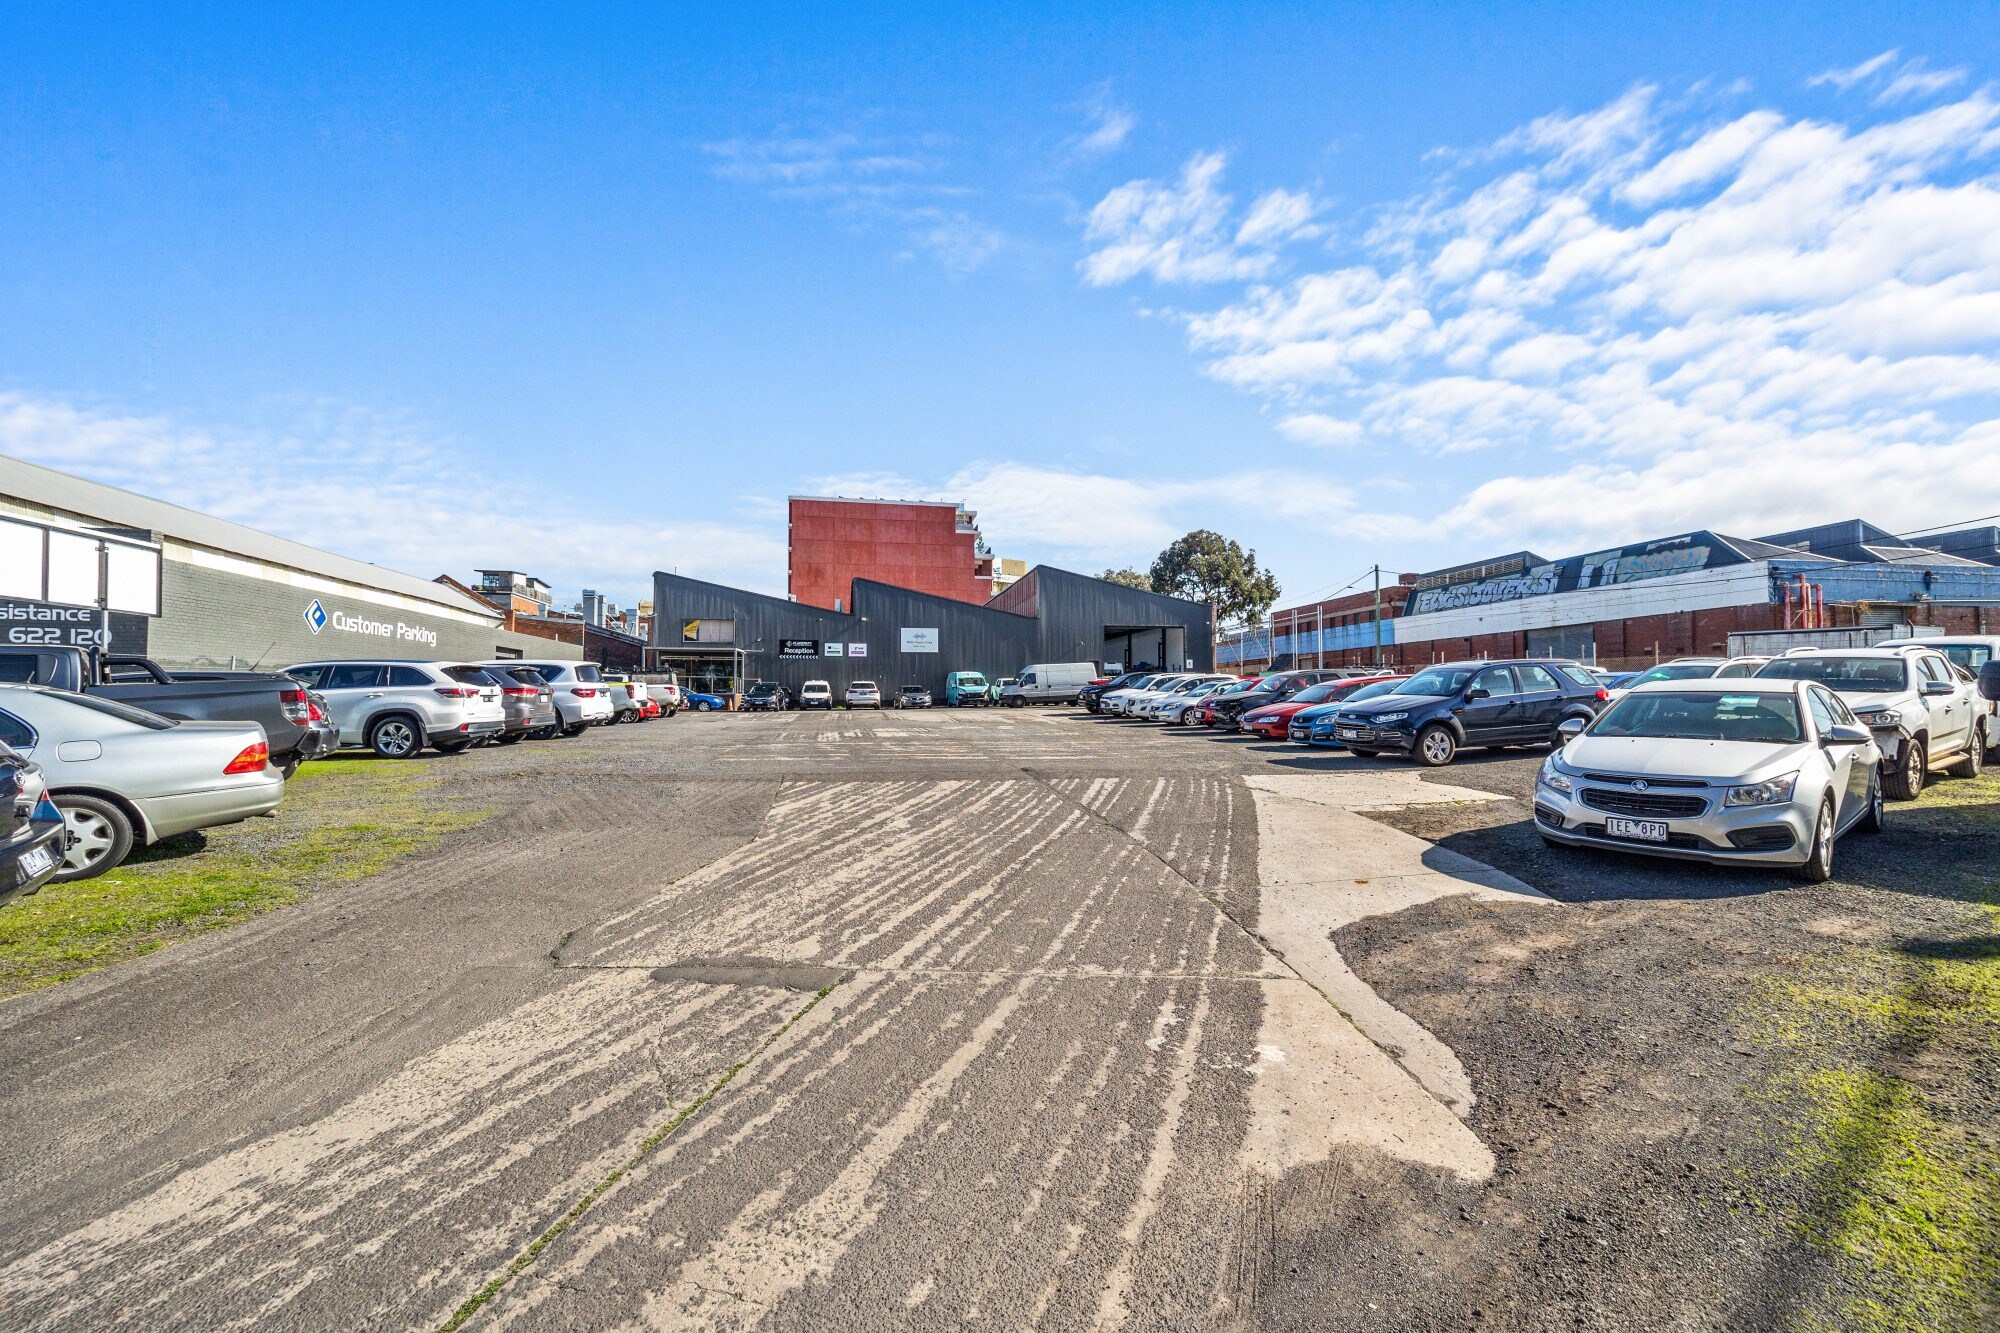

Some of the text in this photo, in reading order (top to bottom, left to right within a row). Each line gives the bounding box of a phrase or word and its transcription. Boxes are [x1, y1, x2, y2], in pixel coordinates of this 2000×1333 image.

[8, 627, 113, 645] 622 120
[332, 611, 437, 647] Customer Parking
[784, 647, 814, 655] Reception
[1641, 823, 1665, 837] 8PD
